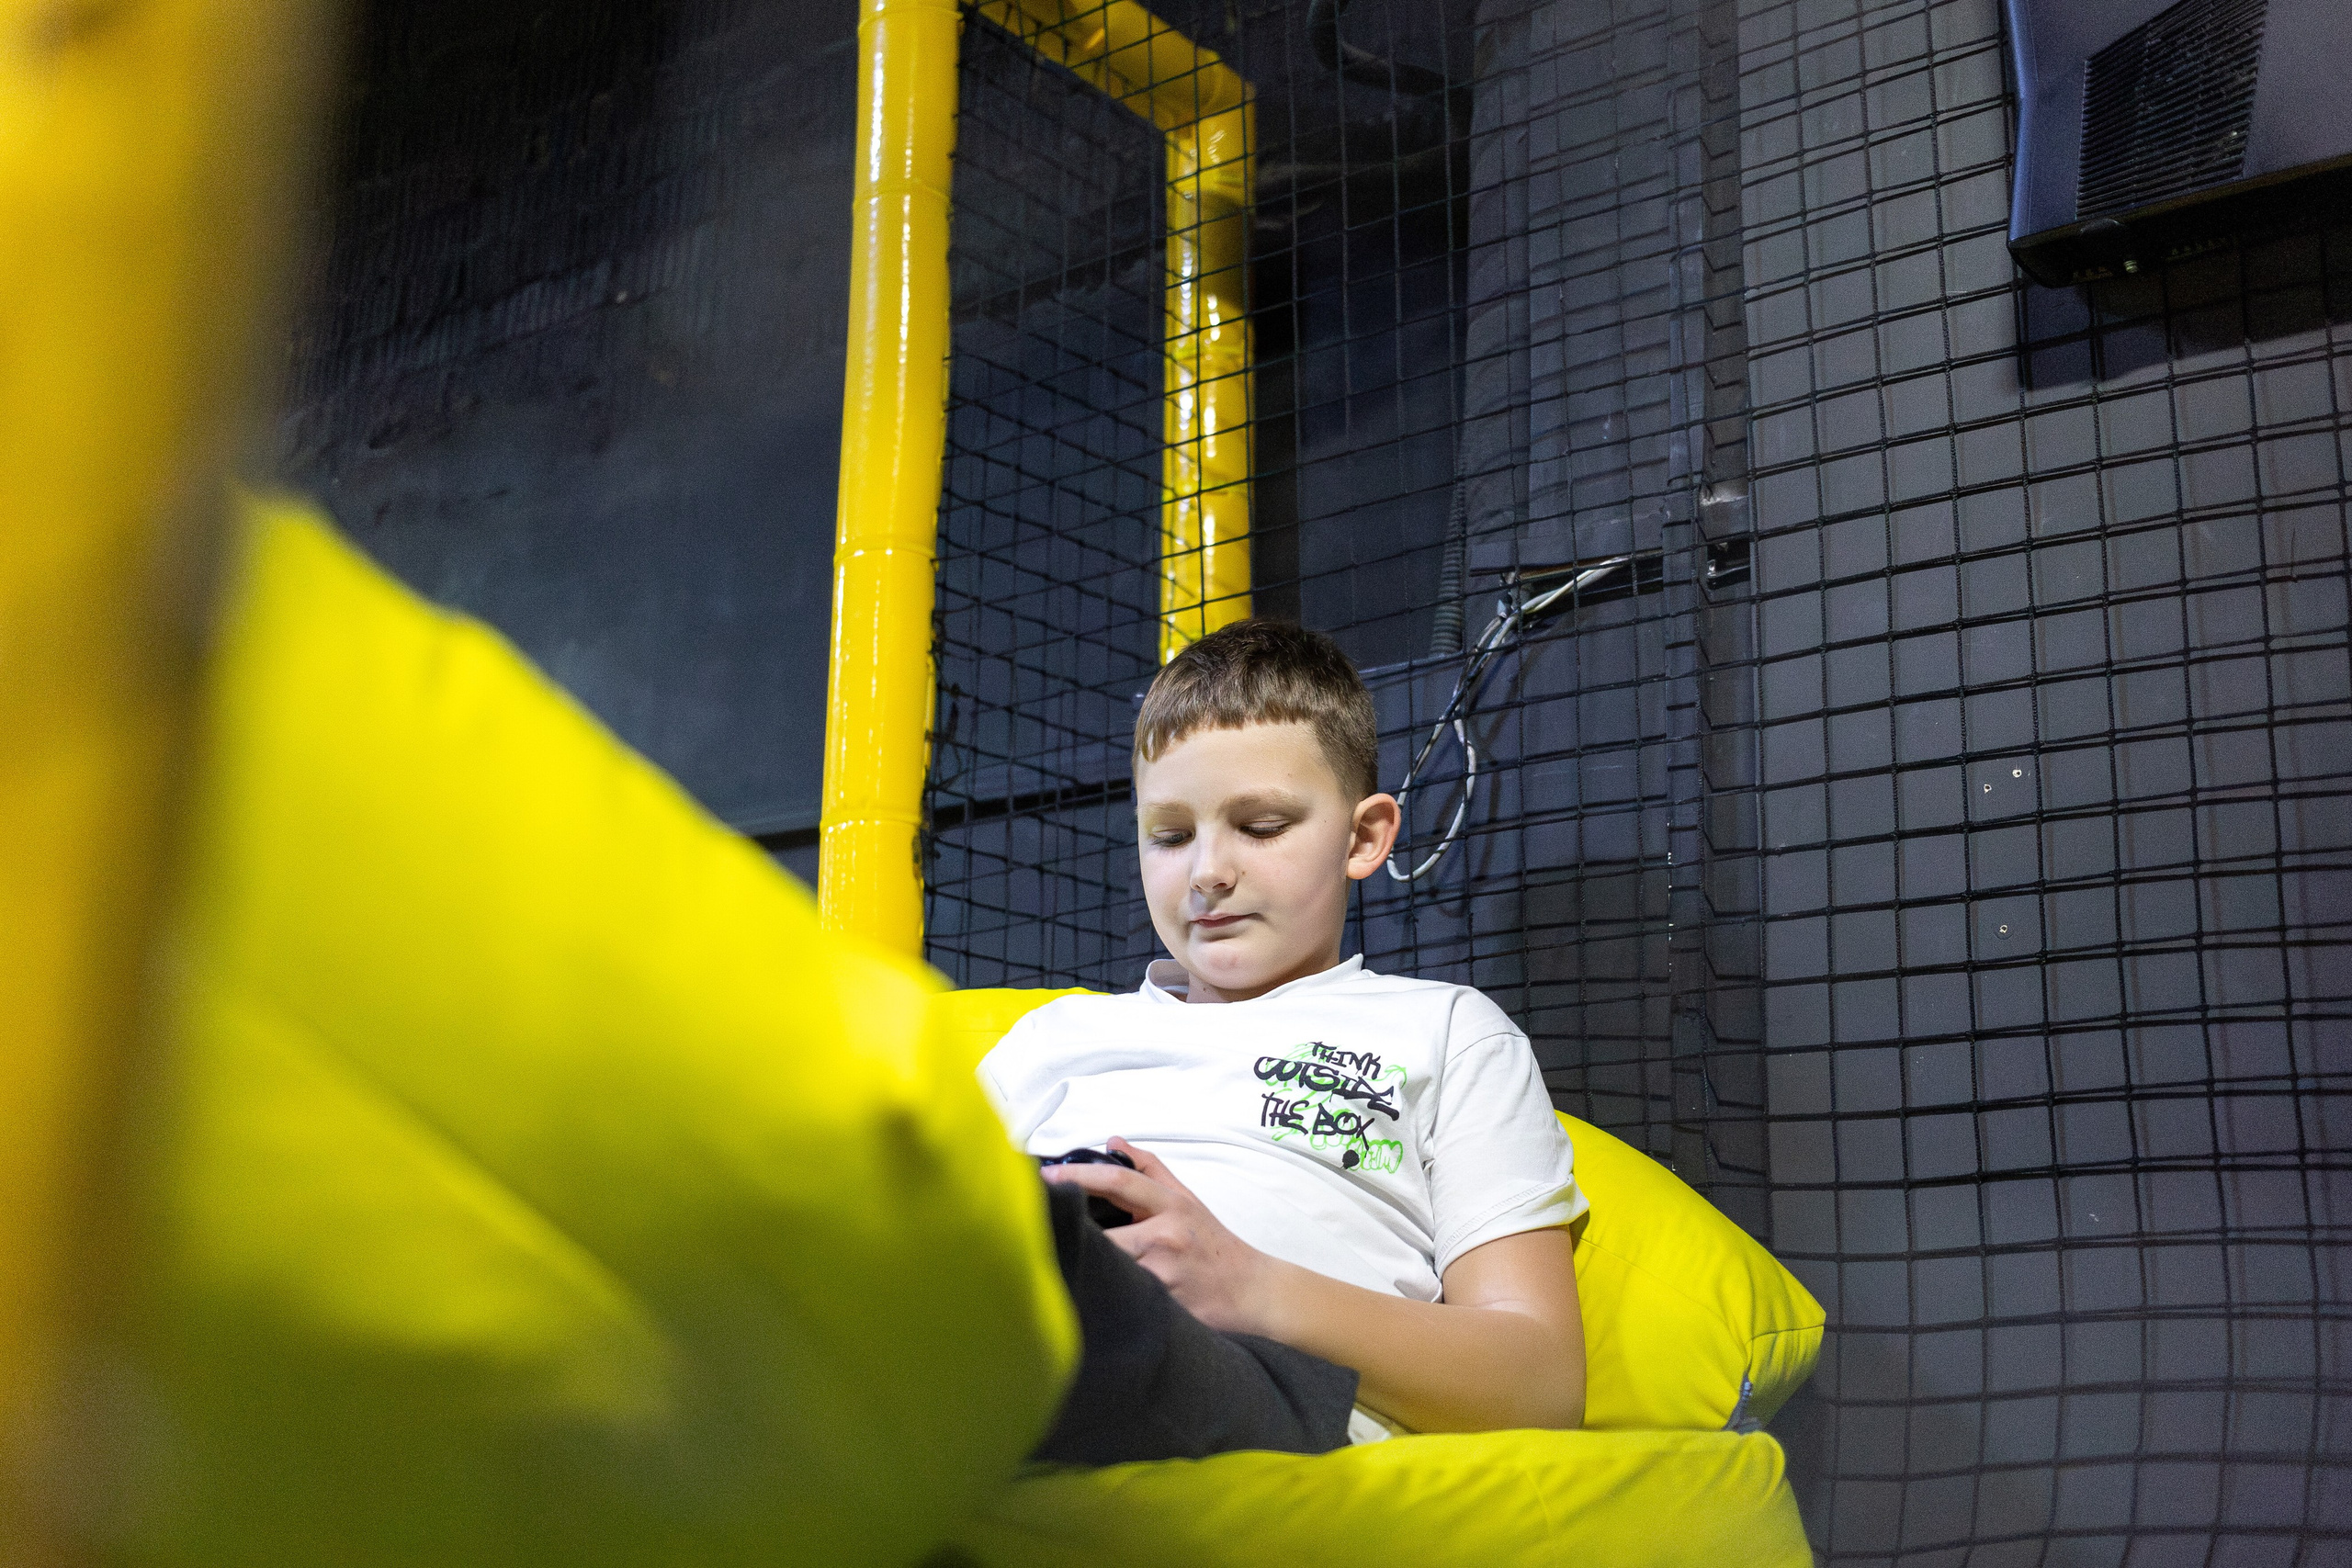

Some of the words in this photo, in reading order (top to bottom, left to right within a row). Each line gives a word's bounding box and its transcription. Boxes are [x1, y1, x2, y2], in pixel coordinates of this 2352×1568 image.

[1306, 1042, 1381, 1080] THINK
[1261, 1092, 1308, 1135] THE
[1312, 1103, 1374, 1157] BOX
